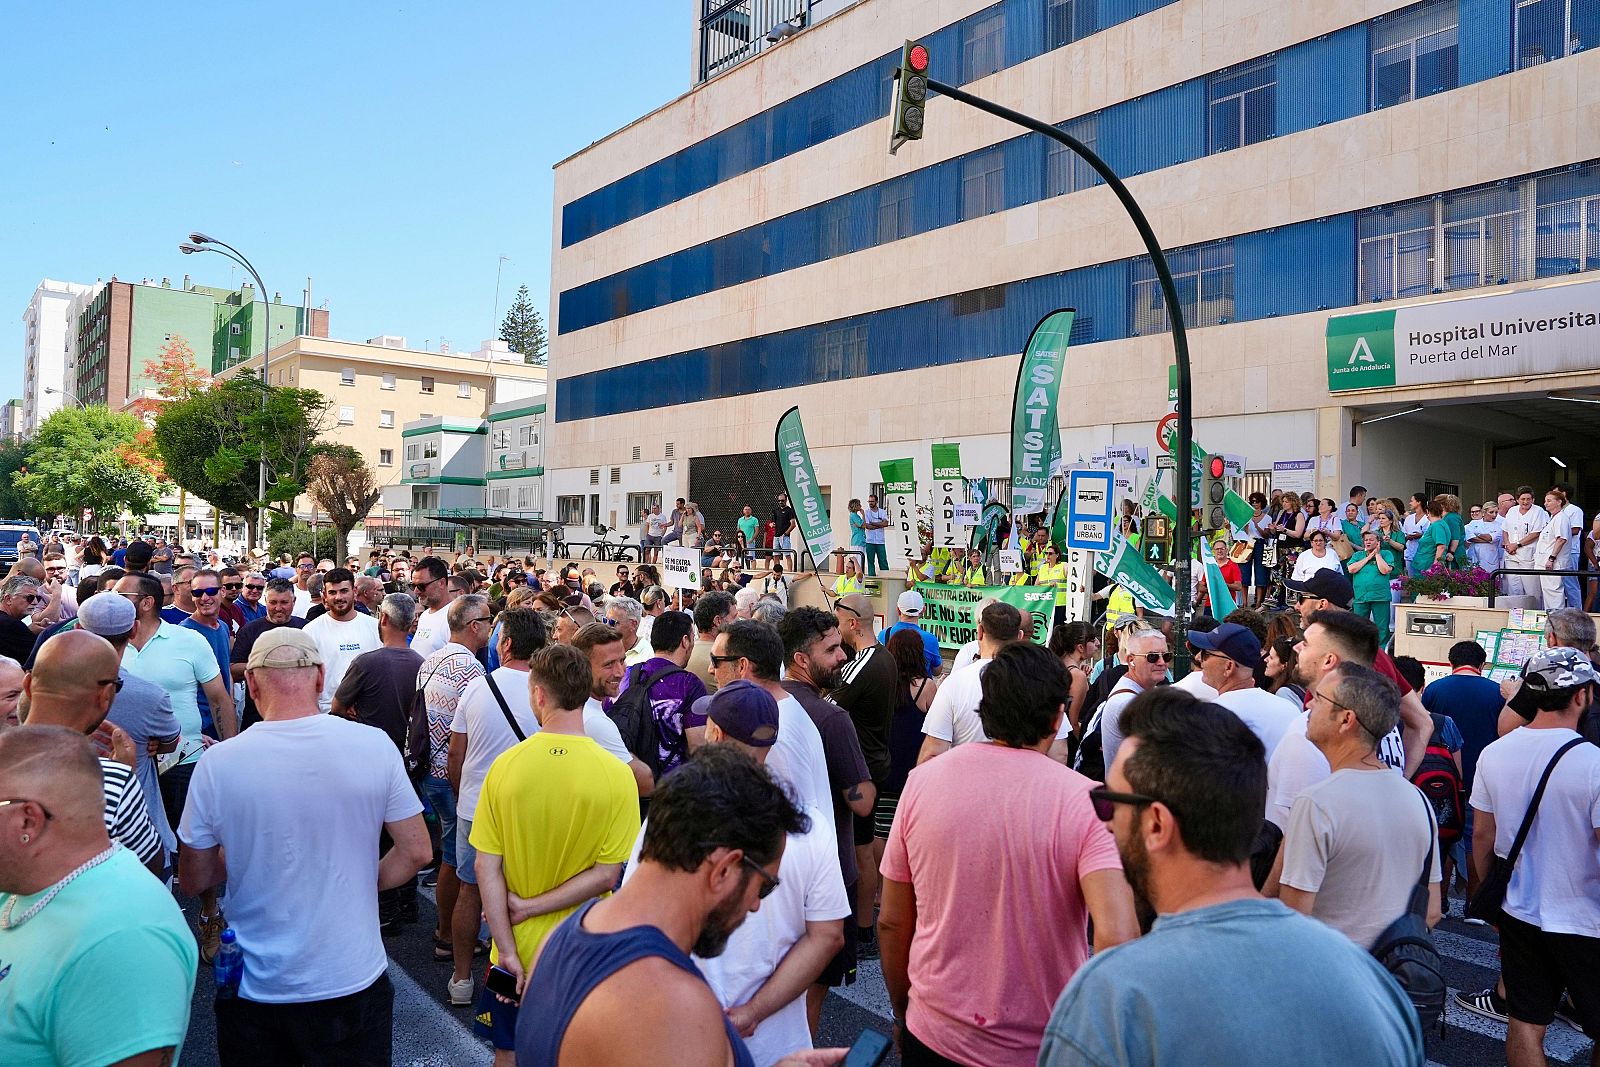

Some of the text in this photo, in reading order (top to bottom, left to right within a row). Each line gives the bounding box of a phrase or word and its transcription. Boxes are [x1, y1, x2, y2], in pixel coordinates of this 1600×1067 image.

[1409, 322, 1484, 346] Hospital
[1410, 343, 1518, 365] Puerta del Mar
[1332, 366, 1350, 374] Junta
[1022, 364, 1055, 473] SATSE
[934, 467, 960, 477] SATSE
[788, 450, 822, 528] SATSE
[887, 481, 913, 491] SATSE
[942, 482, 956, 546] CADIZ
[897, 496, 914, 558] CADIZ
[1083, 523, 1097, 531] BUS
[1076, 531, 1103, 539] URBANO
[676, 558, 691, 566] EXTRA
[925, 588, 957, 602] NUESTRA
[1023, 591, 1053, 601] SATSE
[939, 604, 955, 623] NO
[958, 606, 972, 624] SE
